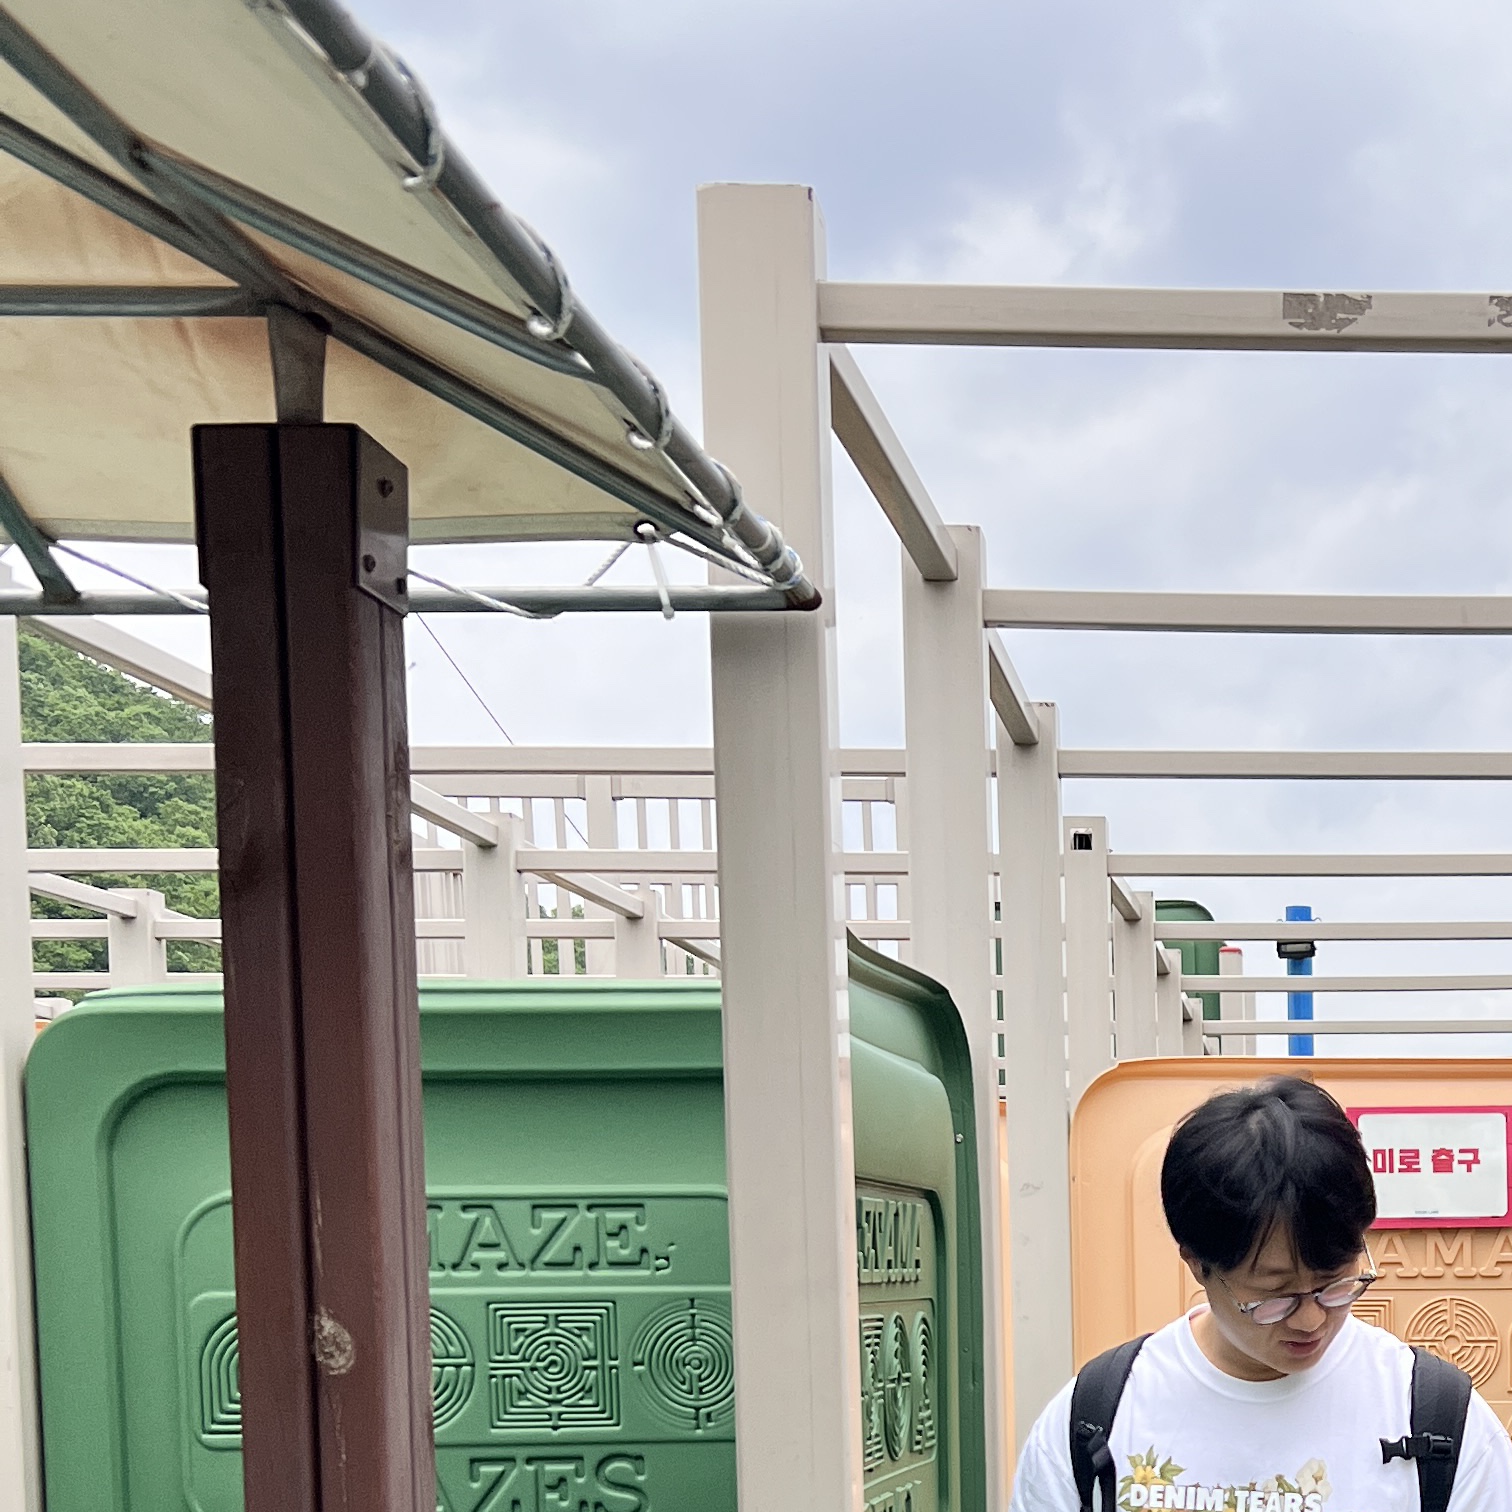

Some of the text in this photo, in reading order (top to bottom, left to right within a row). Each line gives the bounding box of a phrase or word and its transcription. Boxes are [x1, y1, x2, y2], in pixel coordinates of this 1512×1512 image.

[1372, 1147, 1482, 1174] 미로 출구
[426, 1202, 652, 1278] AZE
[1130, 1483, 1224, 1512] DENIM
